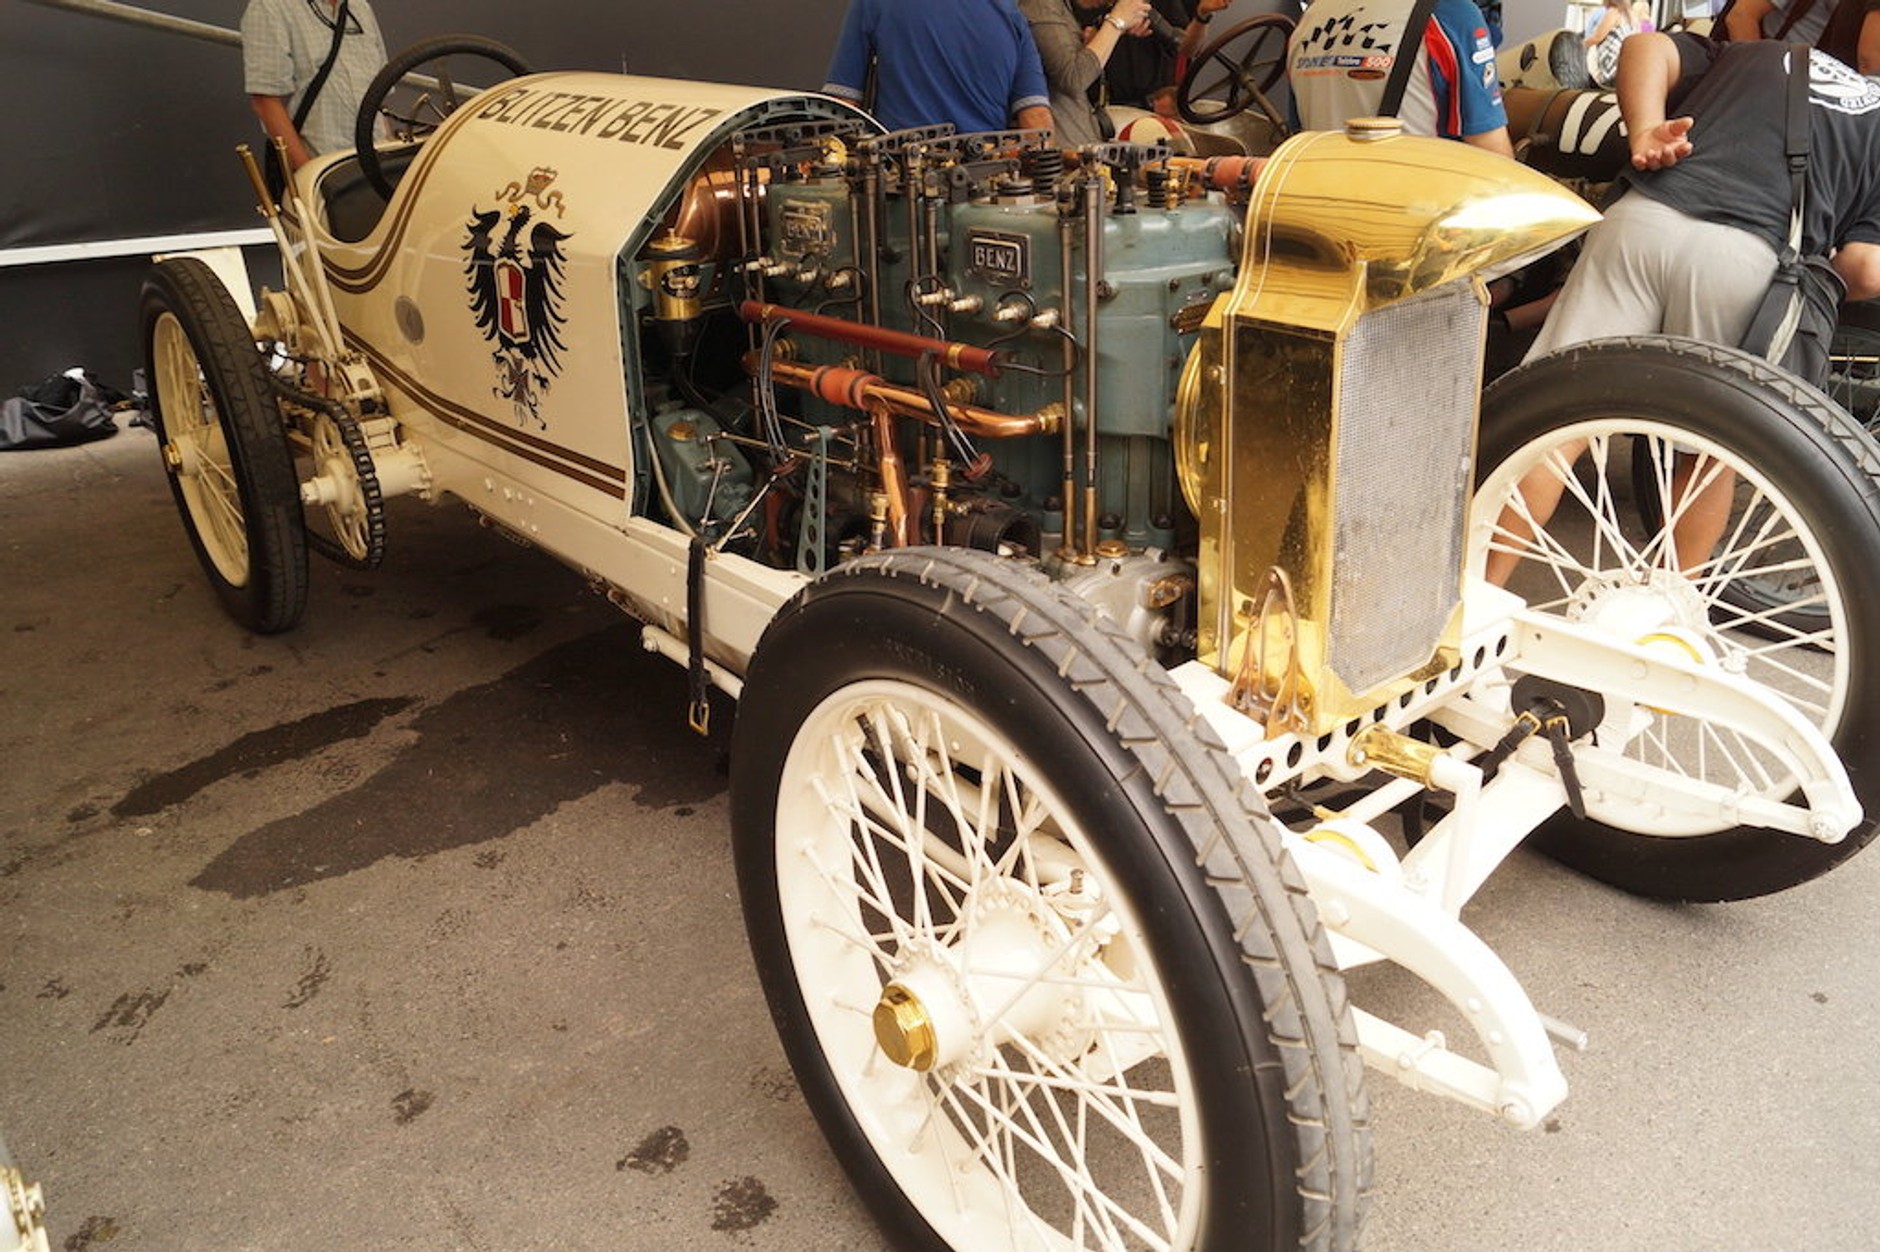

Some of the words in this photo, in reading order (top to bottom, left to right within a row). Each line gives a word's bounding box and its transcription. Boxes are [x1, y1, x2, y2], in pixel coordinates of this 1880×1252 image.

[477, 89, 620, 136] BLITZEN
[597, 101, 722, 150] BENZ
[974, 245, 1017, 272] BENZ
